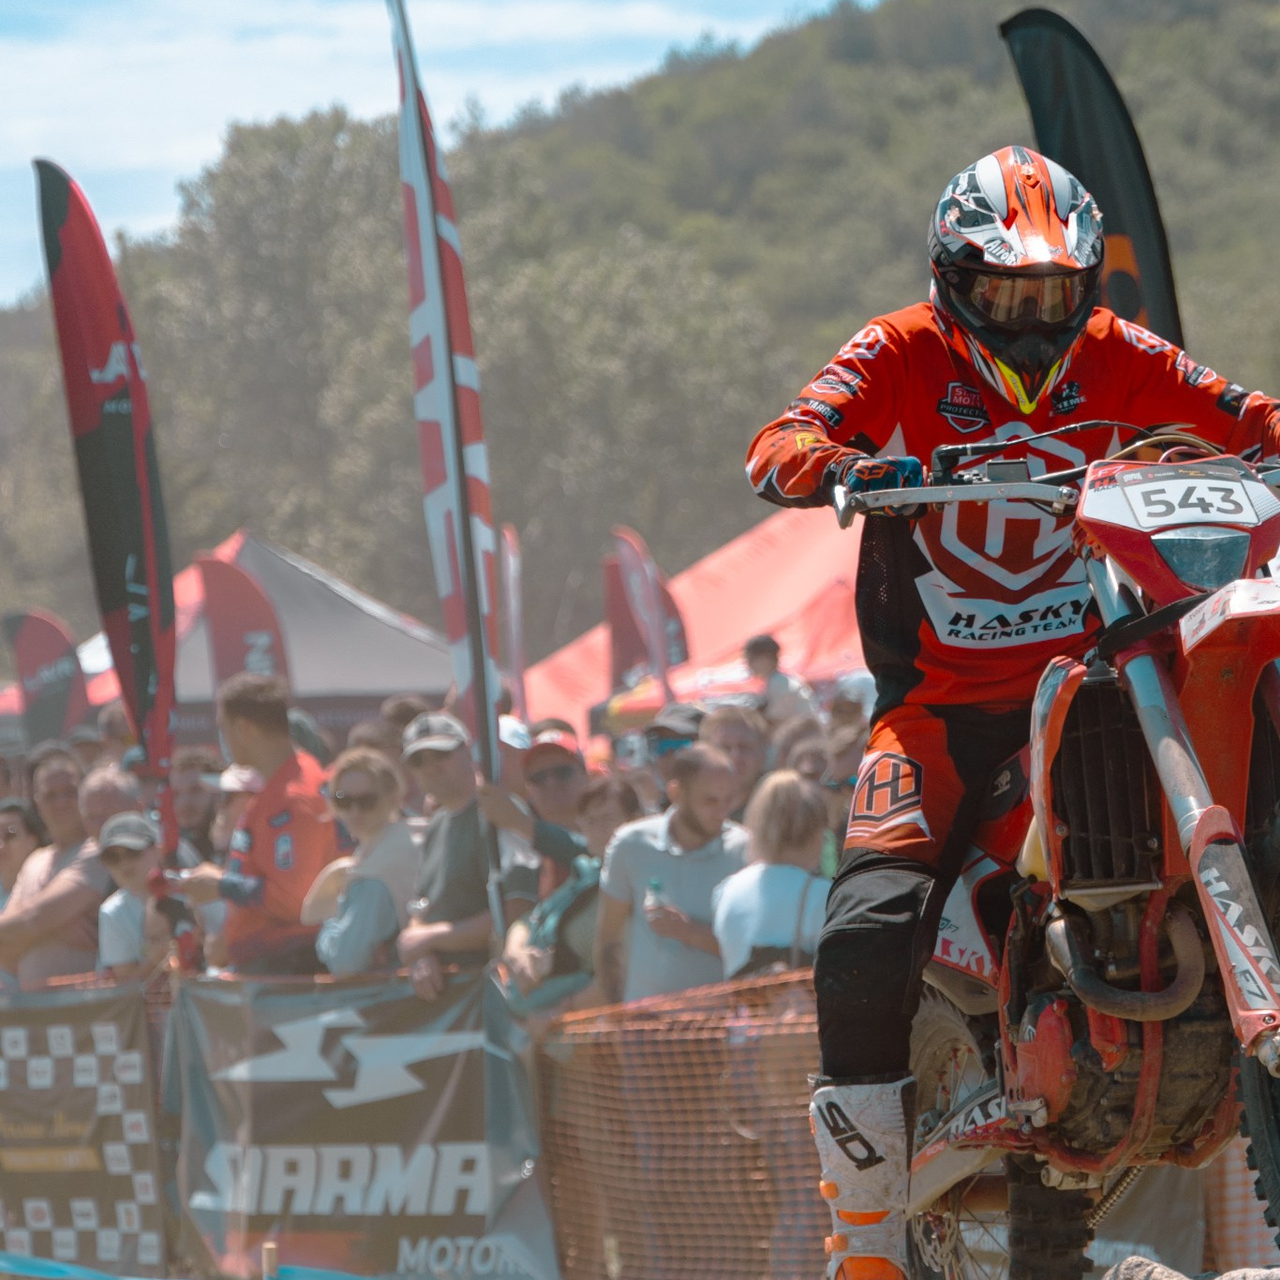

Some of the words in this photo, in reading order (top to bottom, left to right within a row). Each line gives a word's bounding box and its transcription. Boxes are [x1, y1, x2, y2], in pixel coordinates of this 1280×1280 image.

[807, 400, 840, 425] TARGET
[1141, 485, 1244, 518] 543
[948, 598, 1089, 630] HASKY
[947, 627, 1027, 641] RACING
[941, 938, 996, 978] SKY
[1241, 968, 1269, 1002] F7
